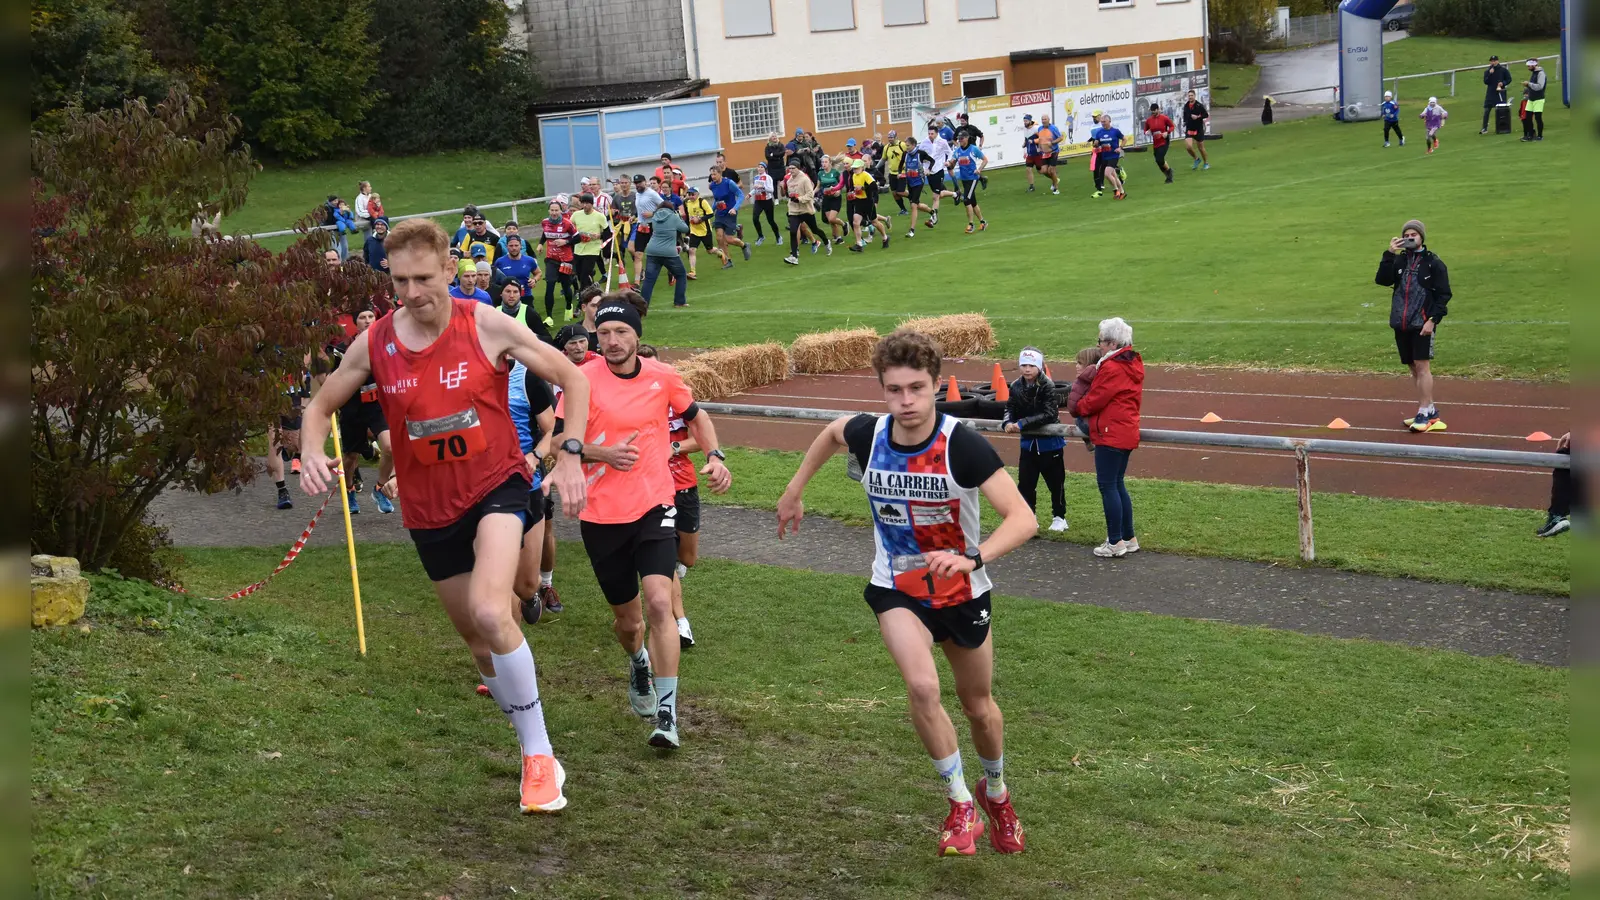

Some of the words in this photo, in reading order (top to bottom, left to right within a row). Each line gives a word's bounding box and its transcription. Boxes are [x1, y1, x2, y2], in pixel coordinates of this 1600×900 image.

[1347, 46, 1369, 54] EnBW
[1020, 91, 1051, 105] GENERALI
[1080, 88, 1130, 105] elektronikbob
[397, 378, 418, 388] HIKE
[429, 435, 468, 461] 70
[869, 471, 882, 487] LA
[887, 473, 949, 492] CARRERA
[869, 485, 906, 497] TRITEAM
[909, 489, 950, 500] ROTHSEE
[921, 572, 936, 595] 1
